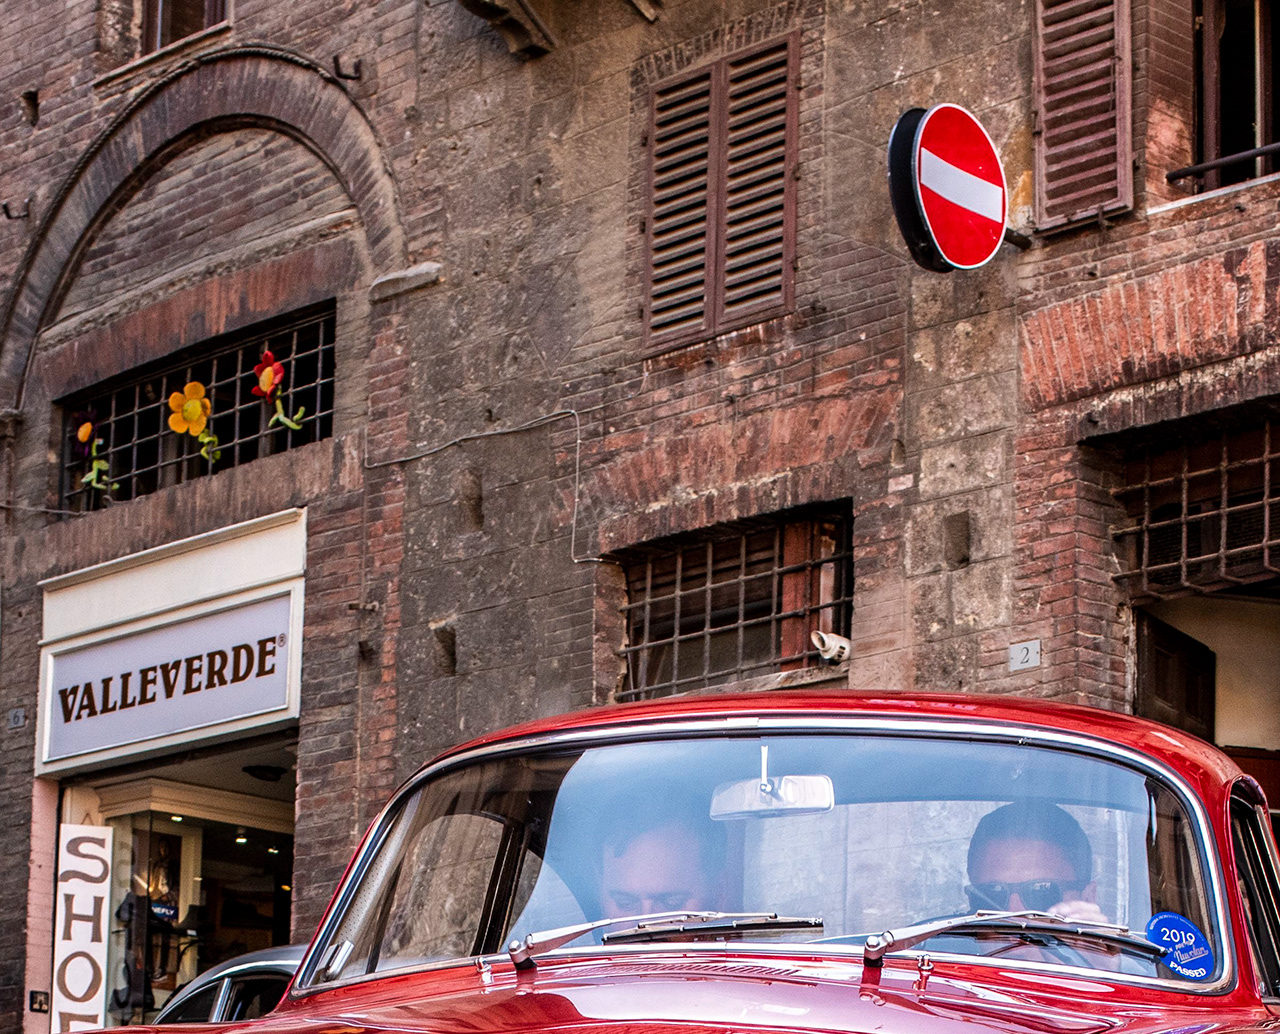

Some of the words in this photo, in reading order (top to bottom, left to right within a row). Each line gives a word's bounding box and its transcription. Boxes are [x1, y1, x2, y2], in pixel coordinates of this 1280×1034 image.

[1020, 647, 1030, 664] 2
[12, 710, 19, 726] 6
[1161, 927, 1196, 946] 2019
[1169, 961, 1207, 978] PASSED
